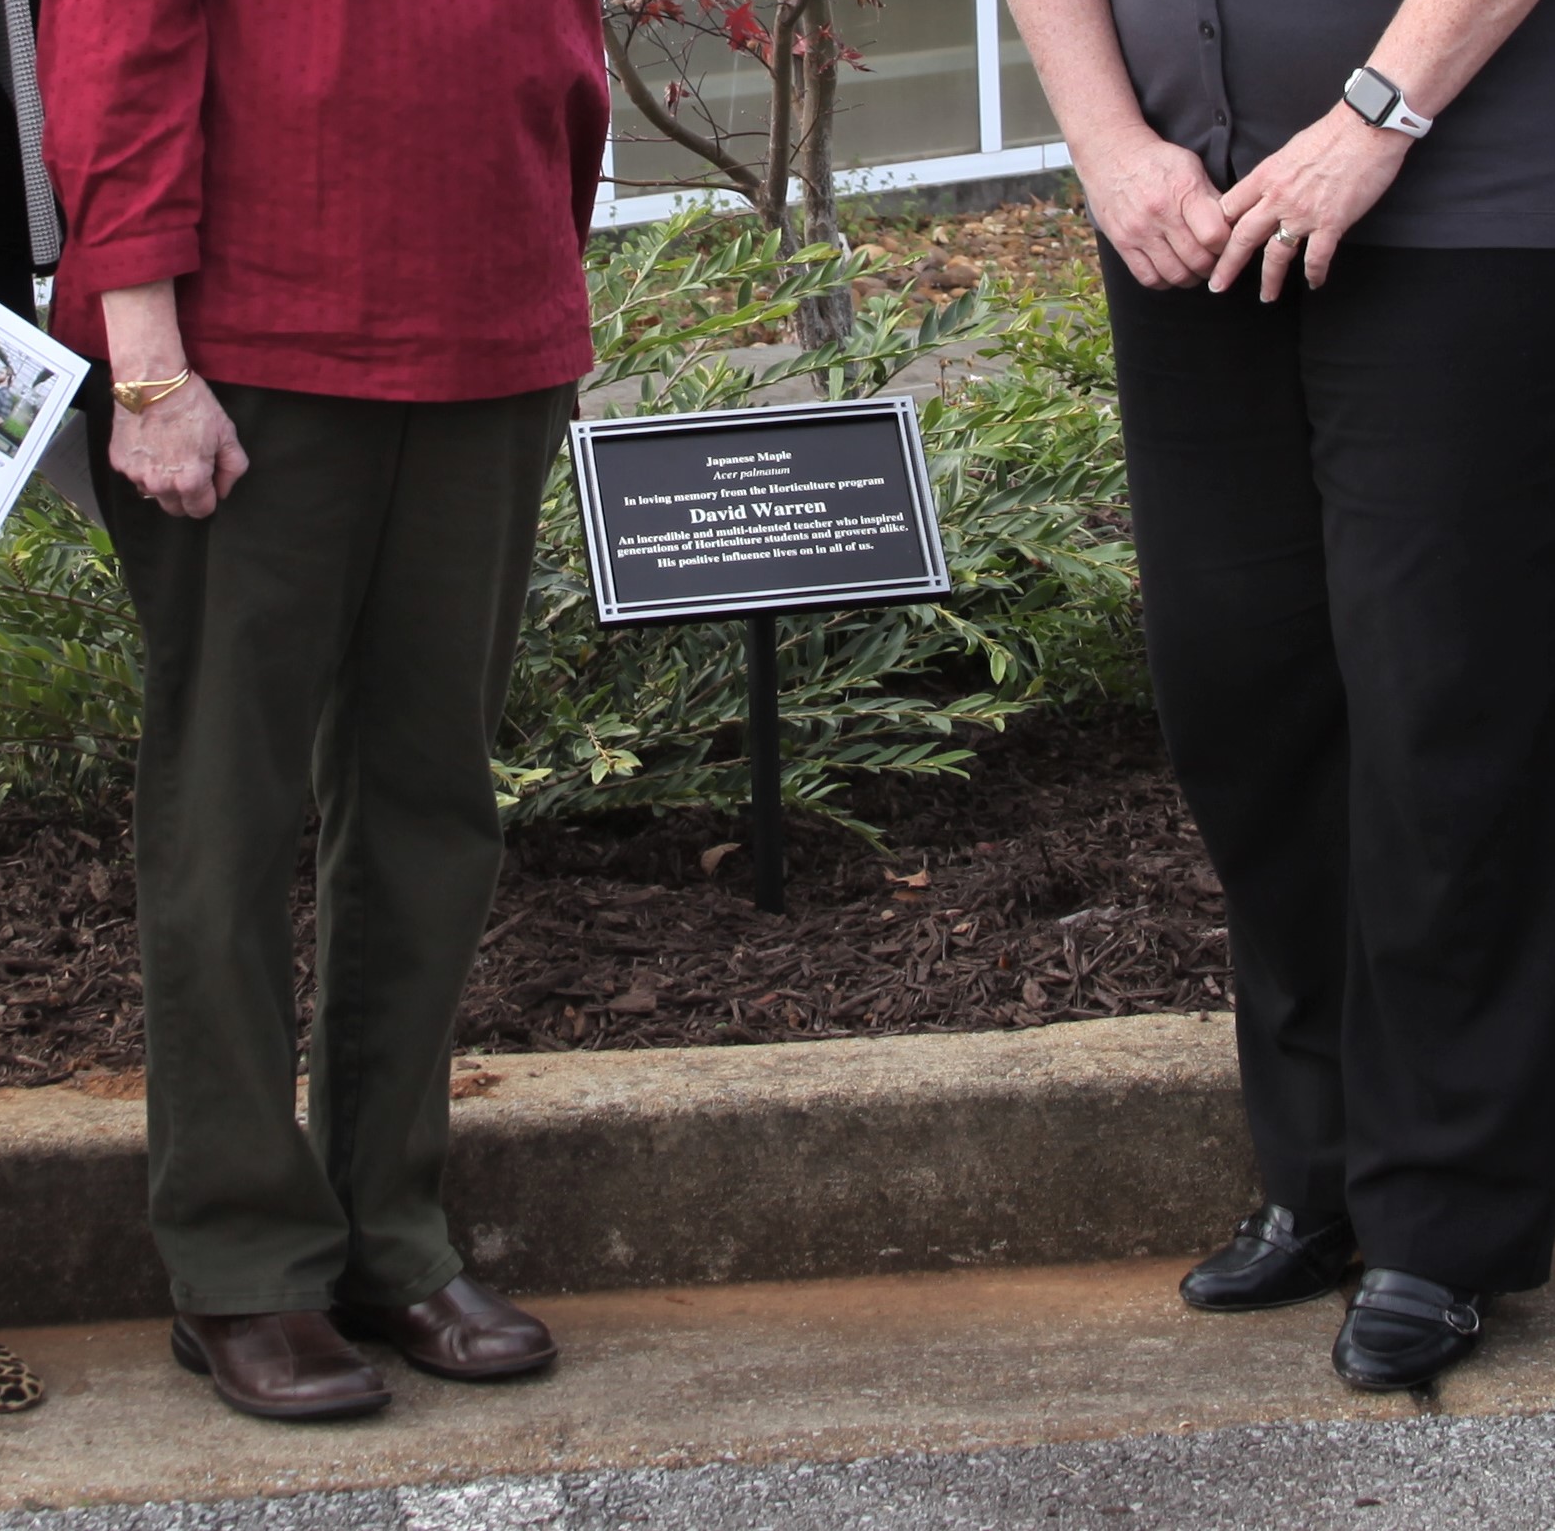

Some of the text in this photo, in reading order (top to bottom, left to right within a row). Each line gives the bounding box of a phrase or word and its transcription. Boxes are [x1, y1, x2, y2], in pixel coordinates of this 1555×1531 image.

[706, 450, 792, 467] Japanese Maple
[713, 467, 790, 480] Acer palmatum
[624, 477, 884, 506] In loving memory from the Horticulture program
[689, 501, 827, 523] David Warren
[617, 523, 909, 558] generations of Horticulture students and growers alike.
[619, 512, 904, 545] An incredible and multi-talented teacher who inspired
[657, 542, 874, 568] His positive influence lives on in all of us.
